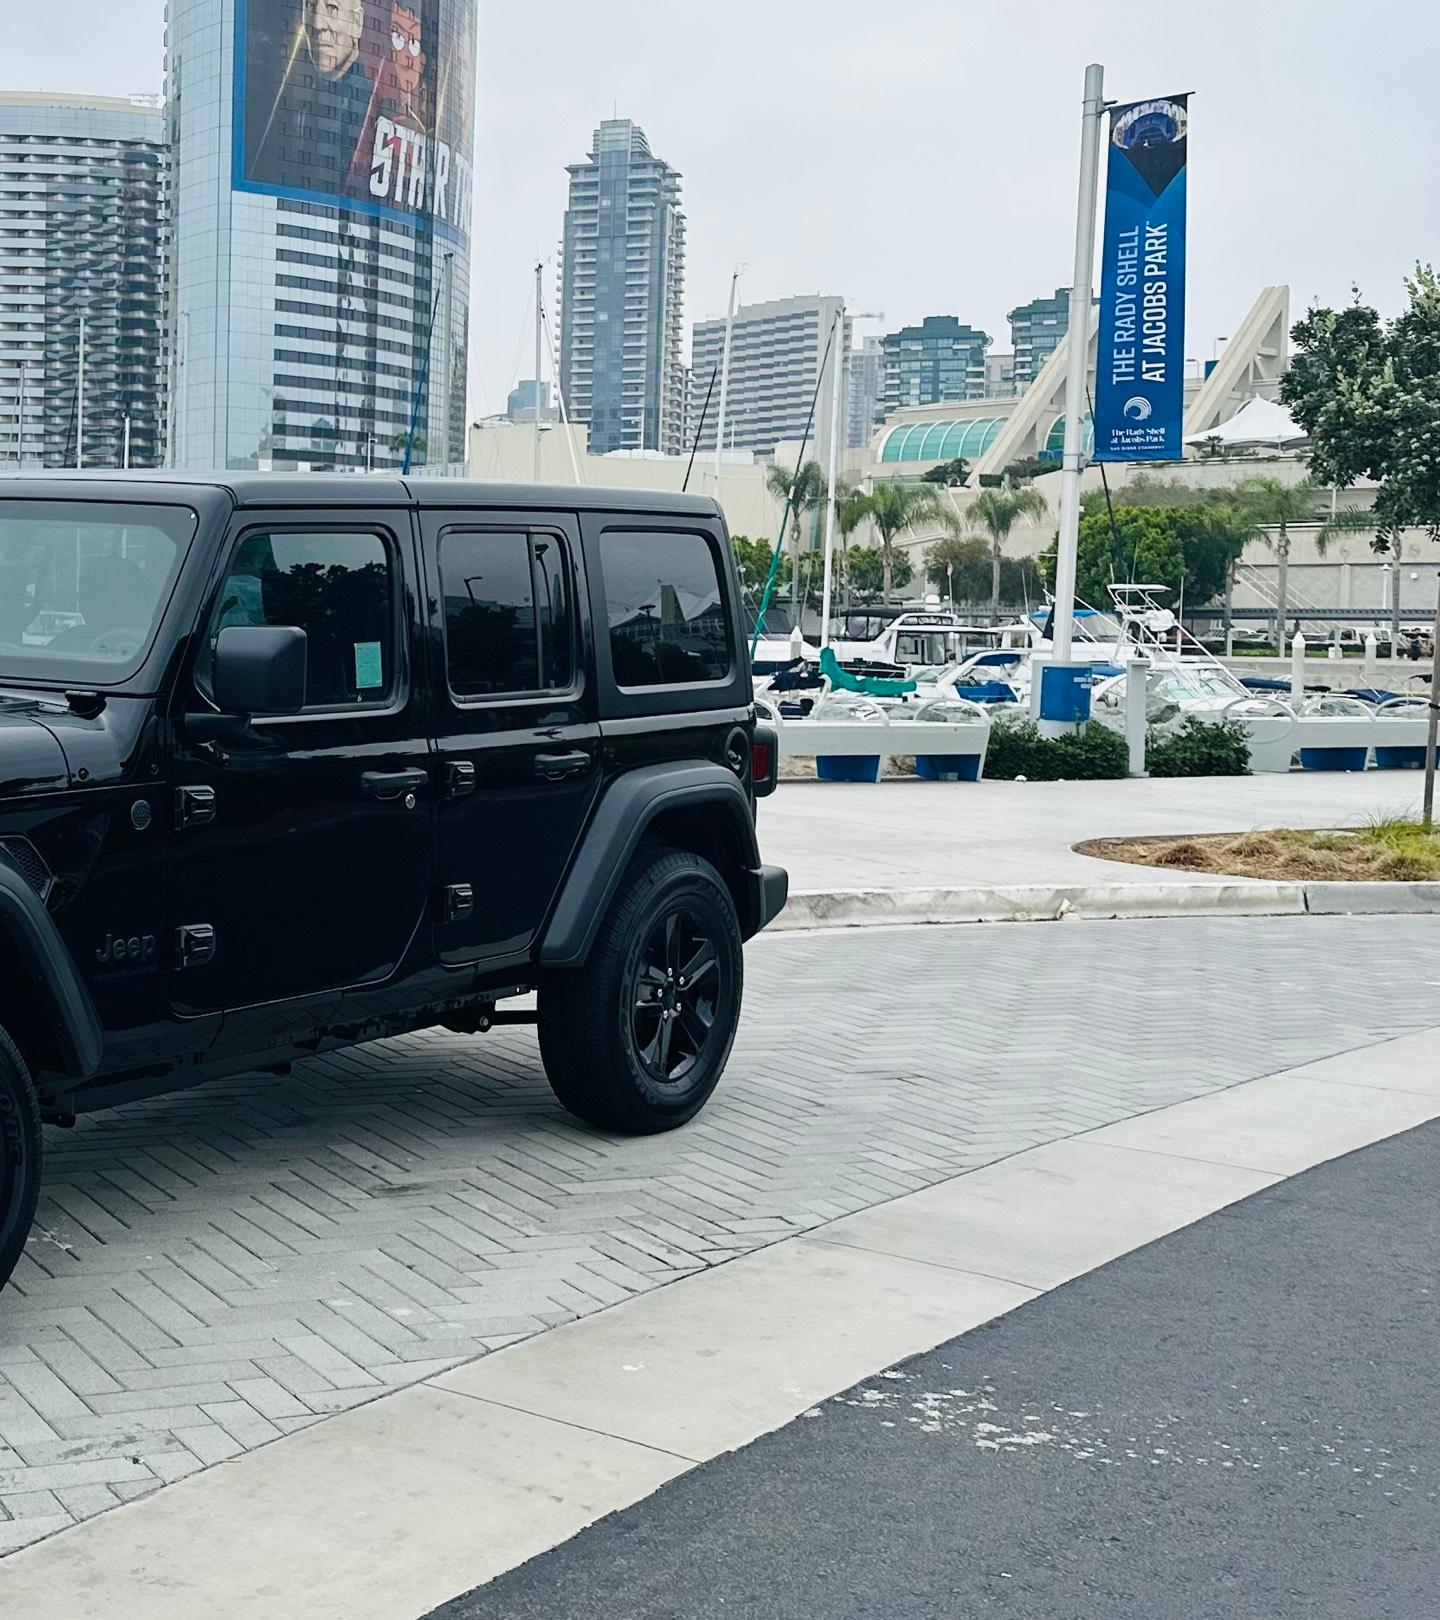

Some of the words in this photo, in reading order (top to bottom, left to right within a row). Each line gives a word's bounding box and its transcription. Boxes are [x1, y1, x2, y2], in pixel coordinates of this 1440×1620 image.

[369, 115, 450, 219] STAR
[1117, 225, 1140, 286] SHELL
[1144, 221, 1168, 275] PARK
[1113, 292, 1137, 344] RADY
[1142, 281, 1167, 356] JACOBS
[1112, 347, 1136, 385] THE
[1141, 358, 1166, 383] AT
[96, 933, 155, 962] Jeep
